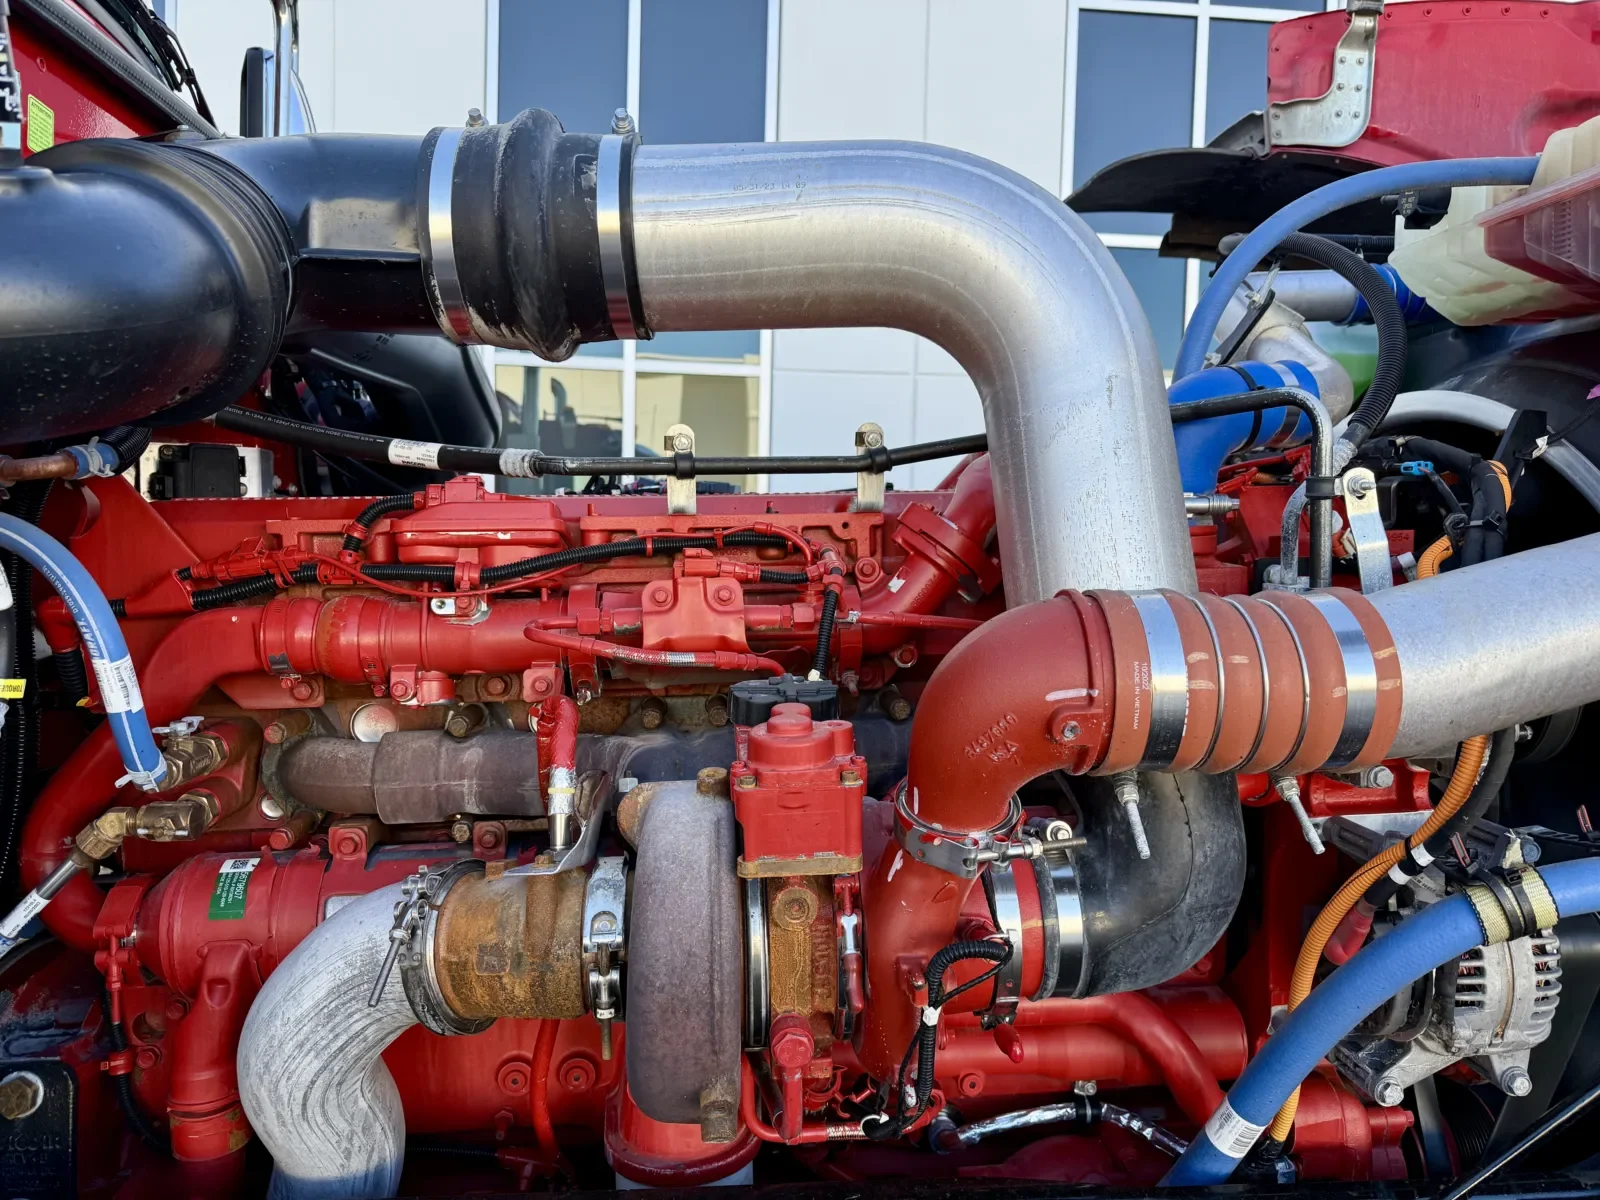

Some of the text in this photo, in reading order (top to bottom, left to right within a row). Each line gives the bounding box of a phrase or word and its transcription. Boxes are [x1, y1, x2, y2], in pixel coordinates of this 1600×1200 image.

[301, 425, 325, 433] SUCTION
[1141, 662, 1149, 690] 10/2022
[1134, 686, 1140, 695] IN
[1133, 696, 1141, 730] VIETNAM
[234, 871, 249, 899] 5679607
